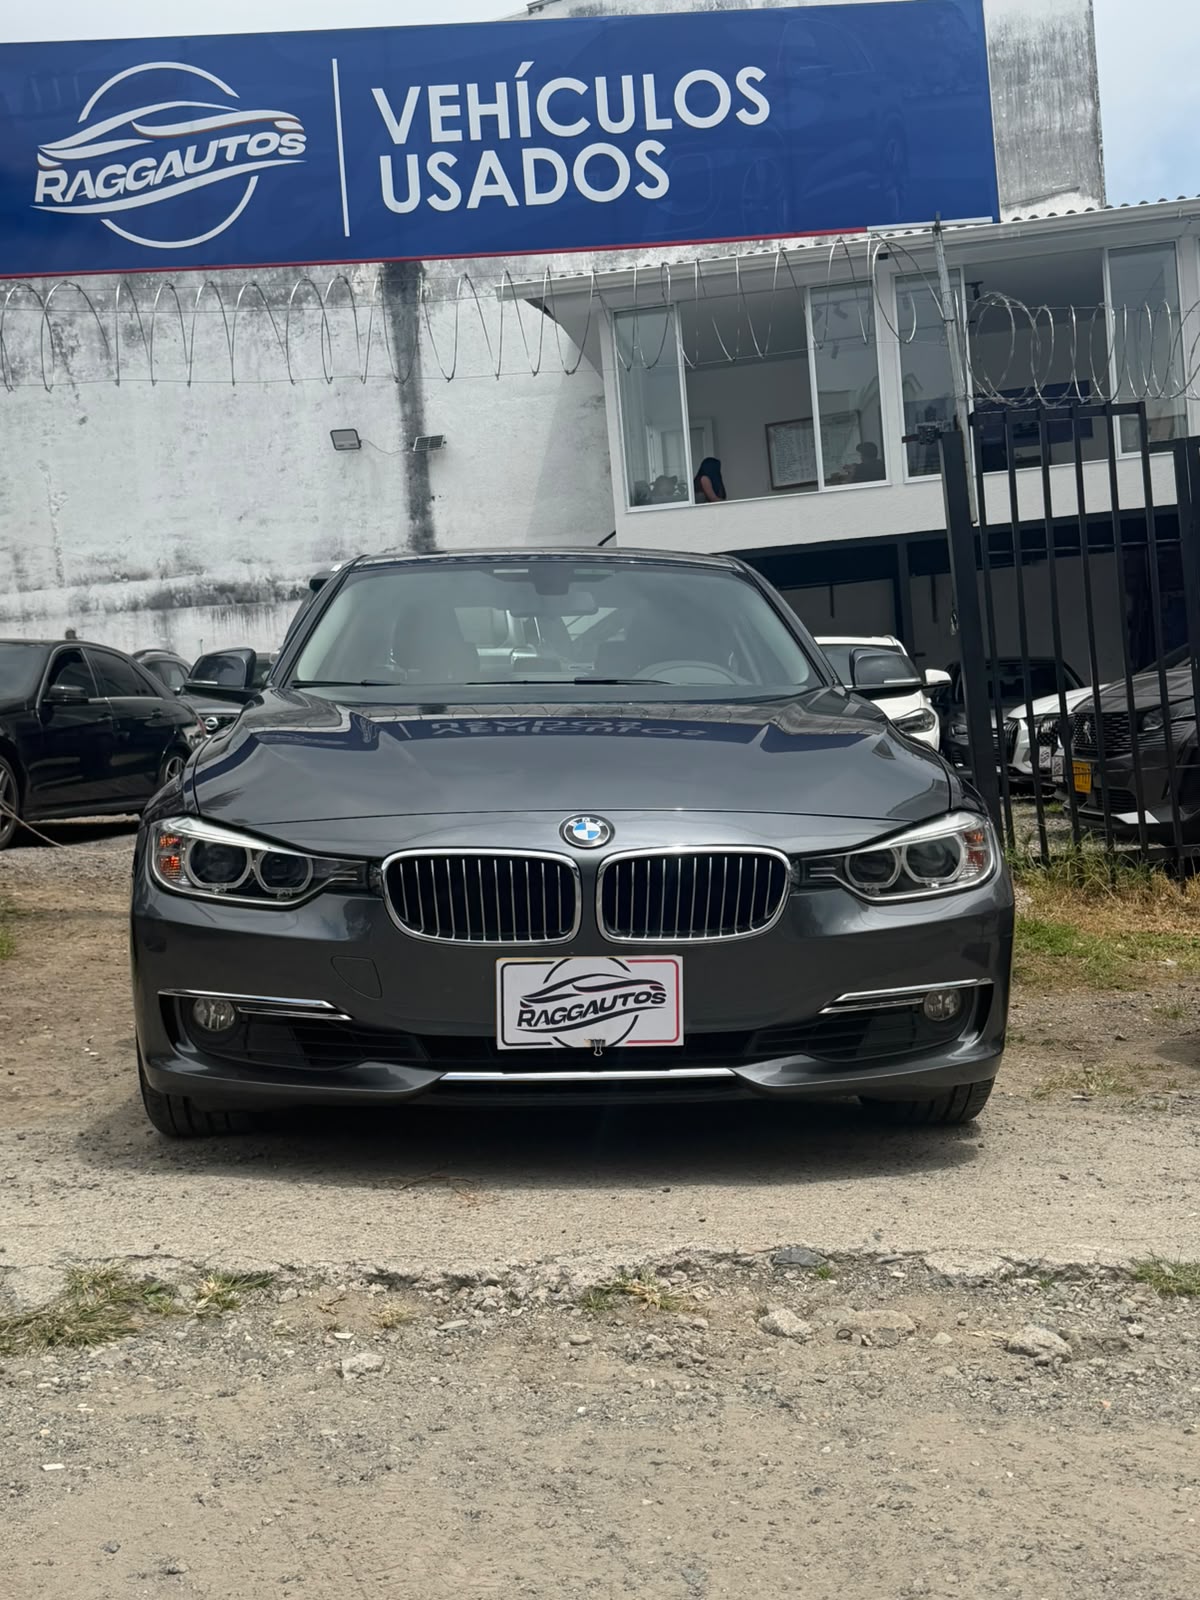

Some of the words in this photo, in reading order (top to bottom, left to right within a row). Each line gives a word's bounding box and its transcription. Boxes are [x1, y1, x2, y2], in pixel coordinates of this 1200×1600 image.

[371, 61, 770, 144] VEHÍCULOS
[34, 132, 307, 203] RAGGAUTOS
[379, 139, 670, 214] USADOS
[517, 991, 667, 1027] RAGGAUTOS
